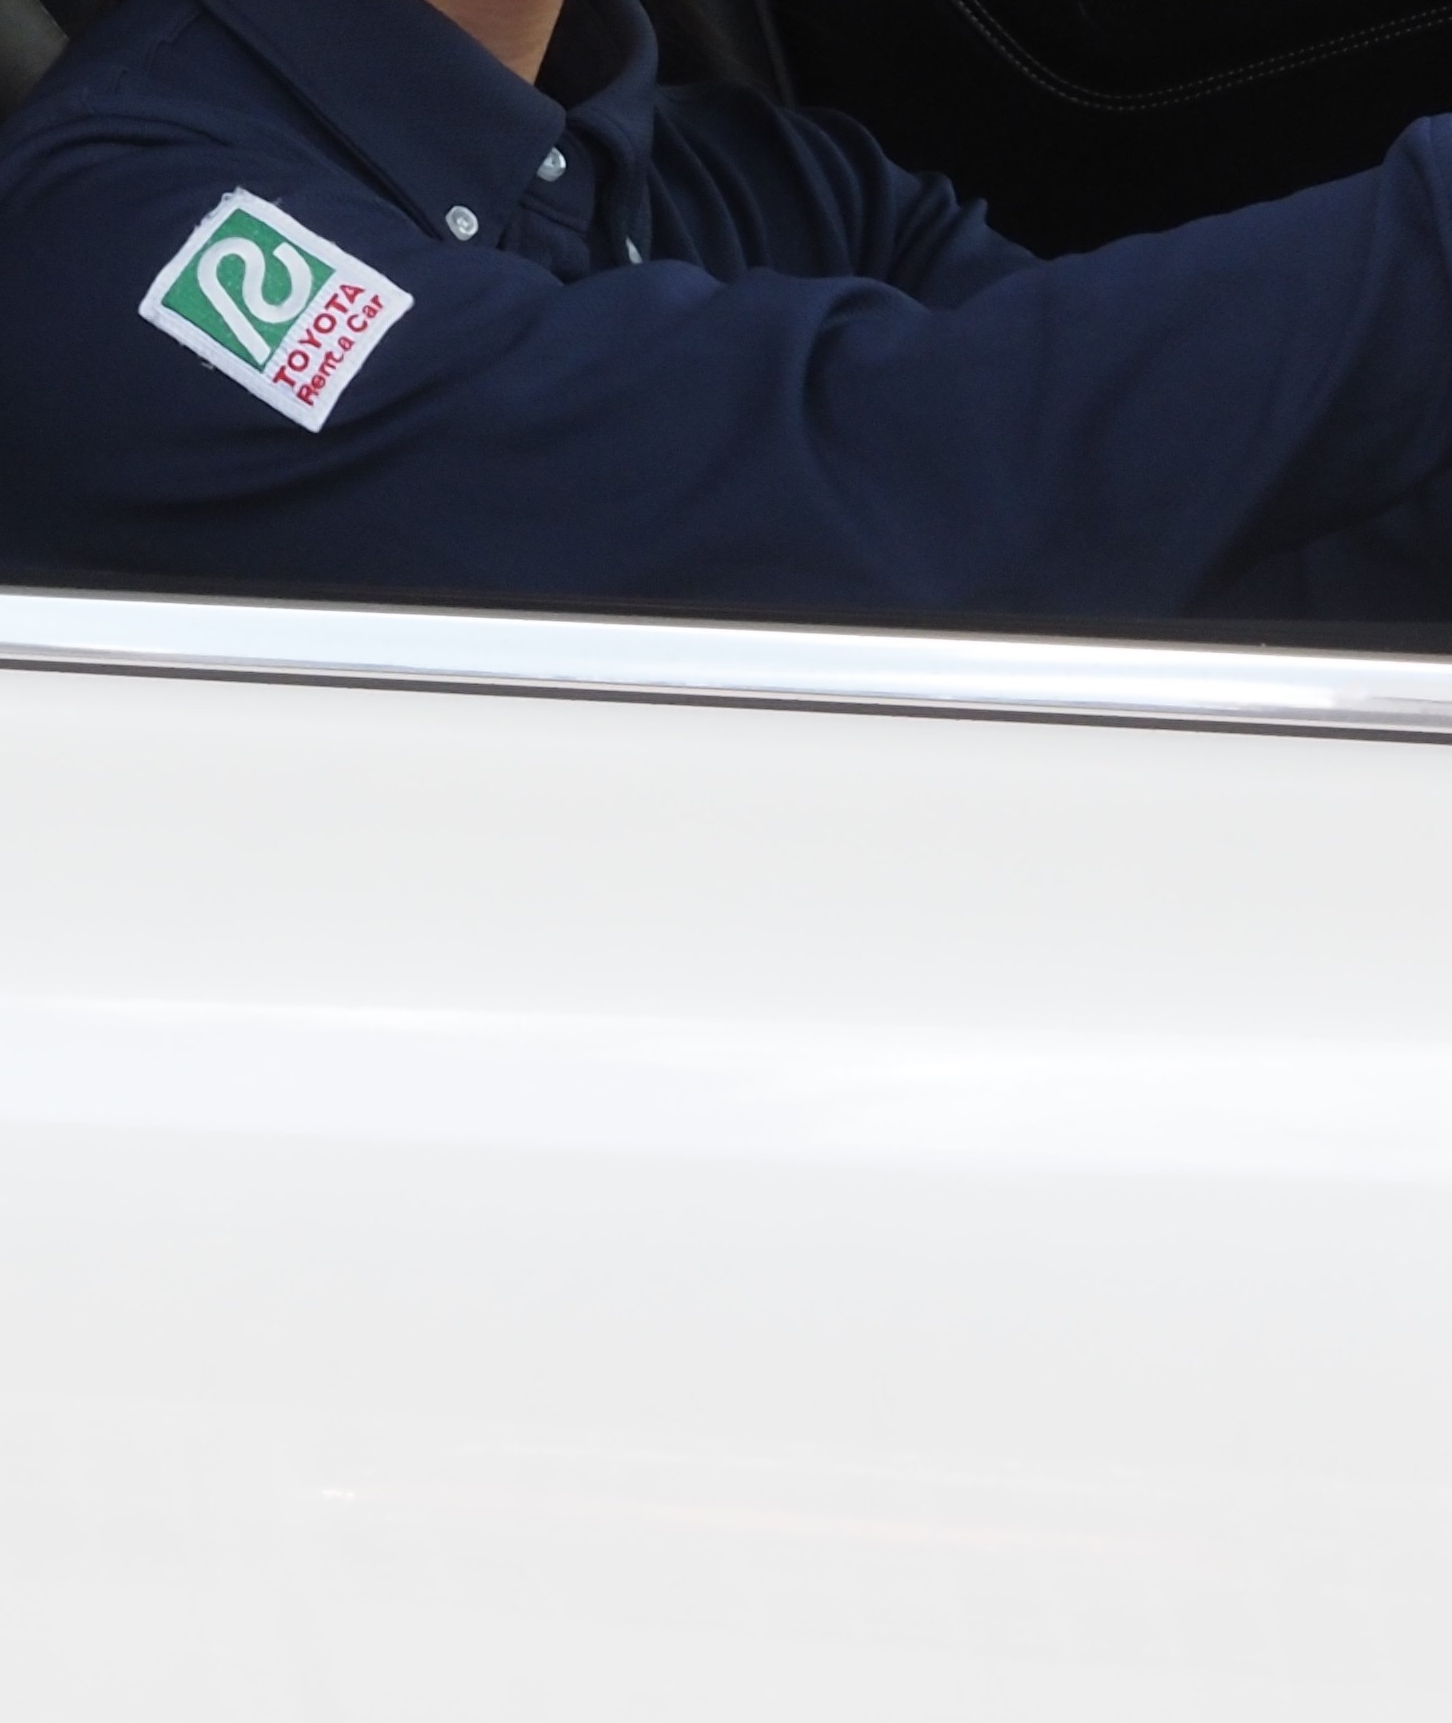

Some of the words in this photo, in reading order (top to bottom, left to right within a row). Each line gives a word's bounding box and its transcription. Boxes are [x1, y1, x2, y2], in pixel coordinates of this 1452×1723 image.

[272, 284, 366, 389] TOYOTA
[346, 294, 384, 332] Car
[338, 335, 356, 352] a
[296, 350, 344, 406] Rent
